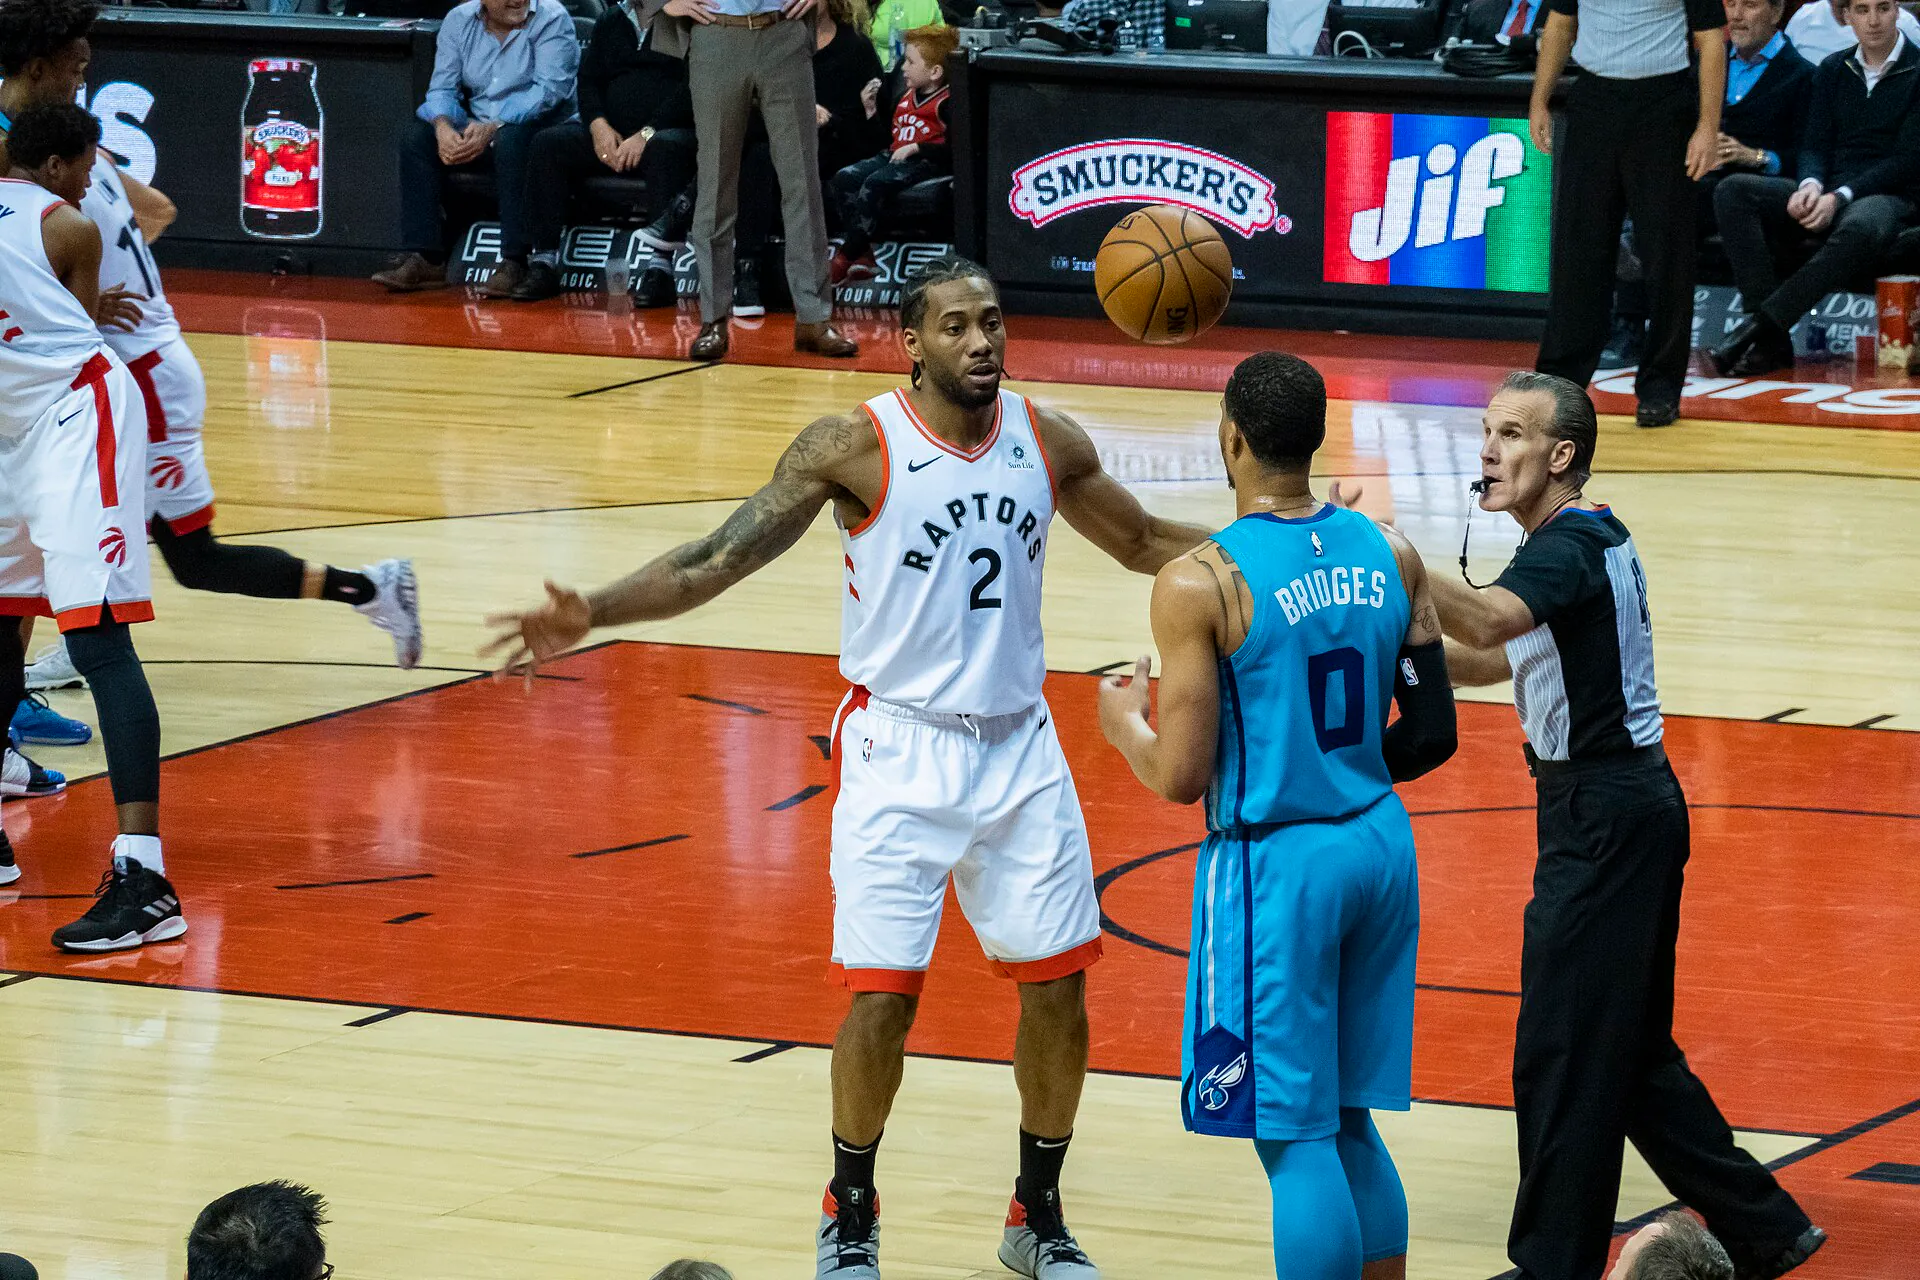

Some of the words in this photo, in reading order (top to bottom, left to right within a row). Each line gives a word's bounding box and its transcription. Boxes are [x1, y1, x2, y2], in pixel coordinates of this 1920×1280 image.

[898, 126, 915, 141] 10
[1033, 153, 1256, 215] SMUCKER'S
[1349, 132, 1526, 262] Jif
[835, 287, 873, 303] YOUR
[1022, 461, 1035, 469] Life
[902, 492, 1042, 573] RAPTORS
[967, 547, 1002, 612] 2
[1274, 566, 1386, 627] BRIDGES
[1308, 646, 1365, 755] 0
